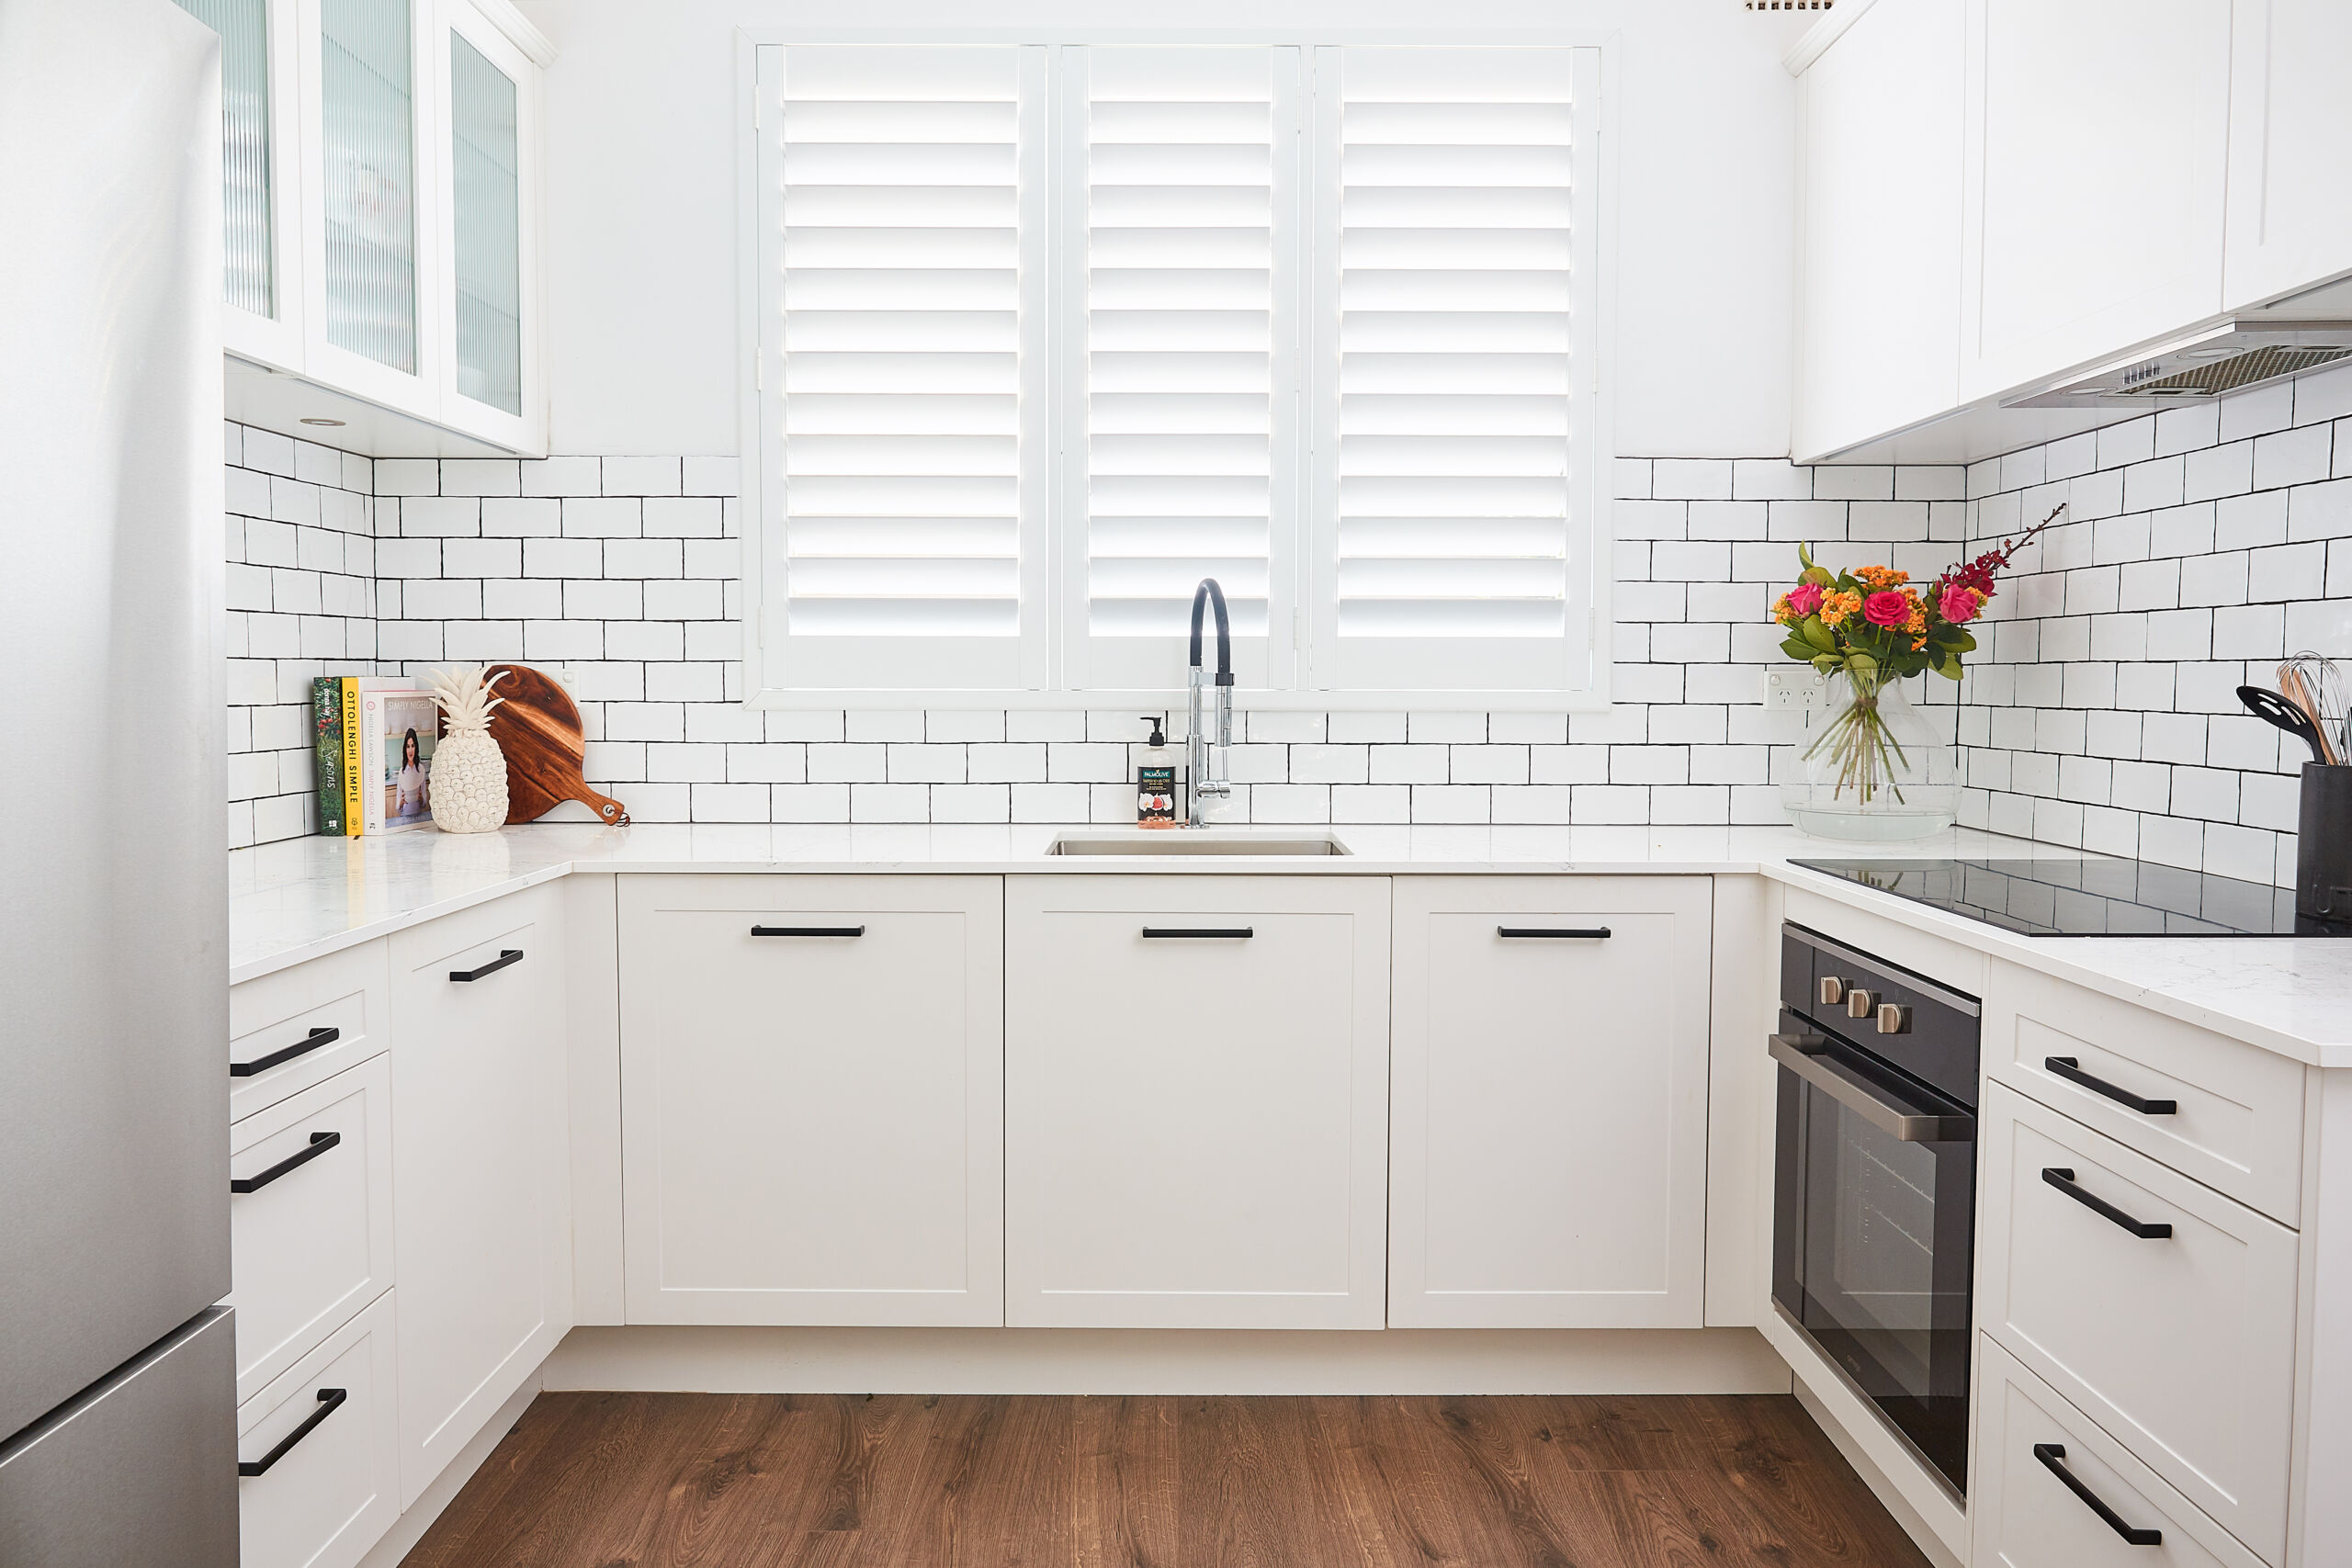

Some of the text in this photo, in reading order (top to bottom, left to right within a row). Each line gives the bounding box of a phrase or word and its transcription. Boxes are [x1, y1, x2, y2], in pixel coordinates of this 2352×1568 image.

[388, 700, 433, 711] SIMPLY NIGELLA
[347, 691, 358, 803] OTTOLENGHI SIMPLE
